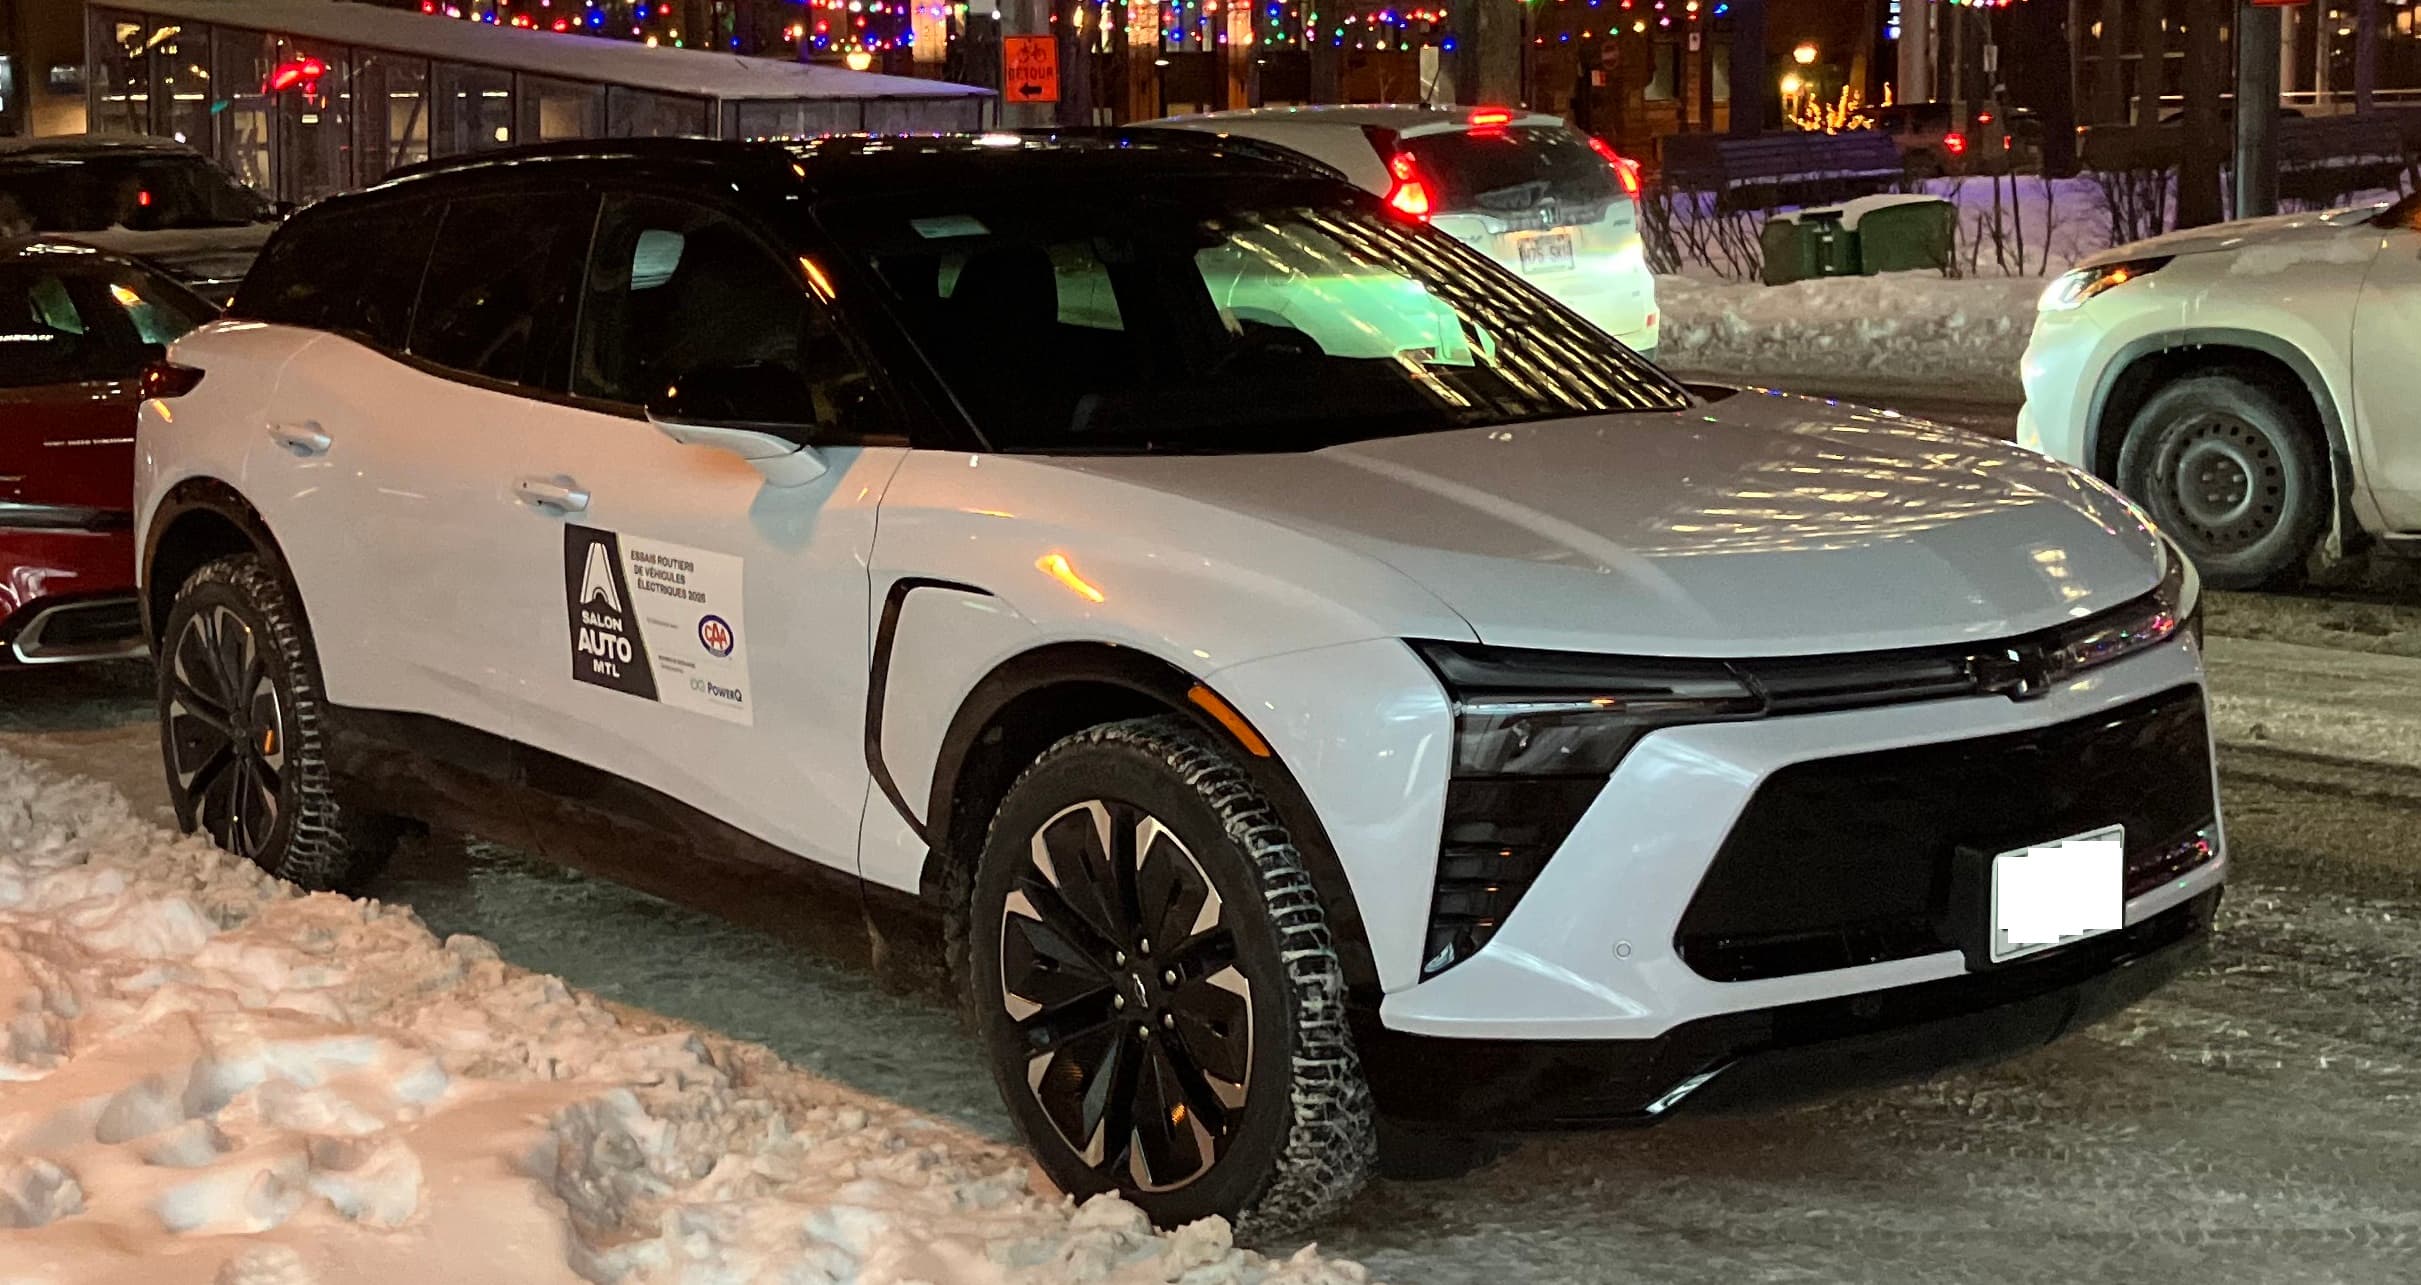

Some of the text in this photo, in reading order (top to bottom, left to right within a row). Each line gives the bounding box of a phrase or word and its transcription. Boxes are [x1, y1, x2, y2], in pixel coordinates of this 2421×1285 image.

[1008, 66, 1053, 80] DETOUR
[631, 550, 694, 573] ESSAIS ROUTIERS
[634, 564, 685, 585] DE VÉHICULES
[638, 578, 687, 599] ÉLECTRIQUES
[582, 610, 622, 632] SALON
[578, 627, 632, 662] AUTO
[705, 622, 728, 649] CAA
[593, 659, 620, 678] MTL
